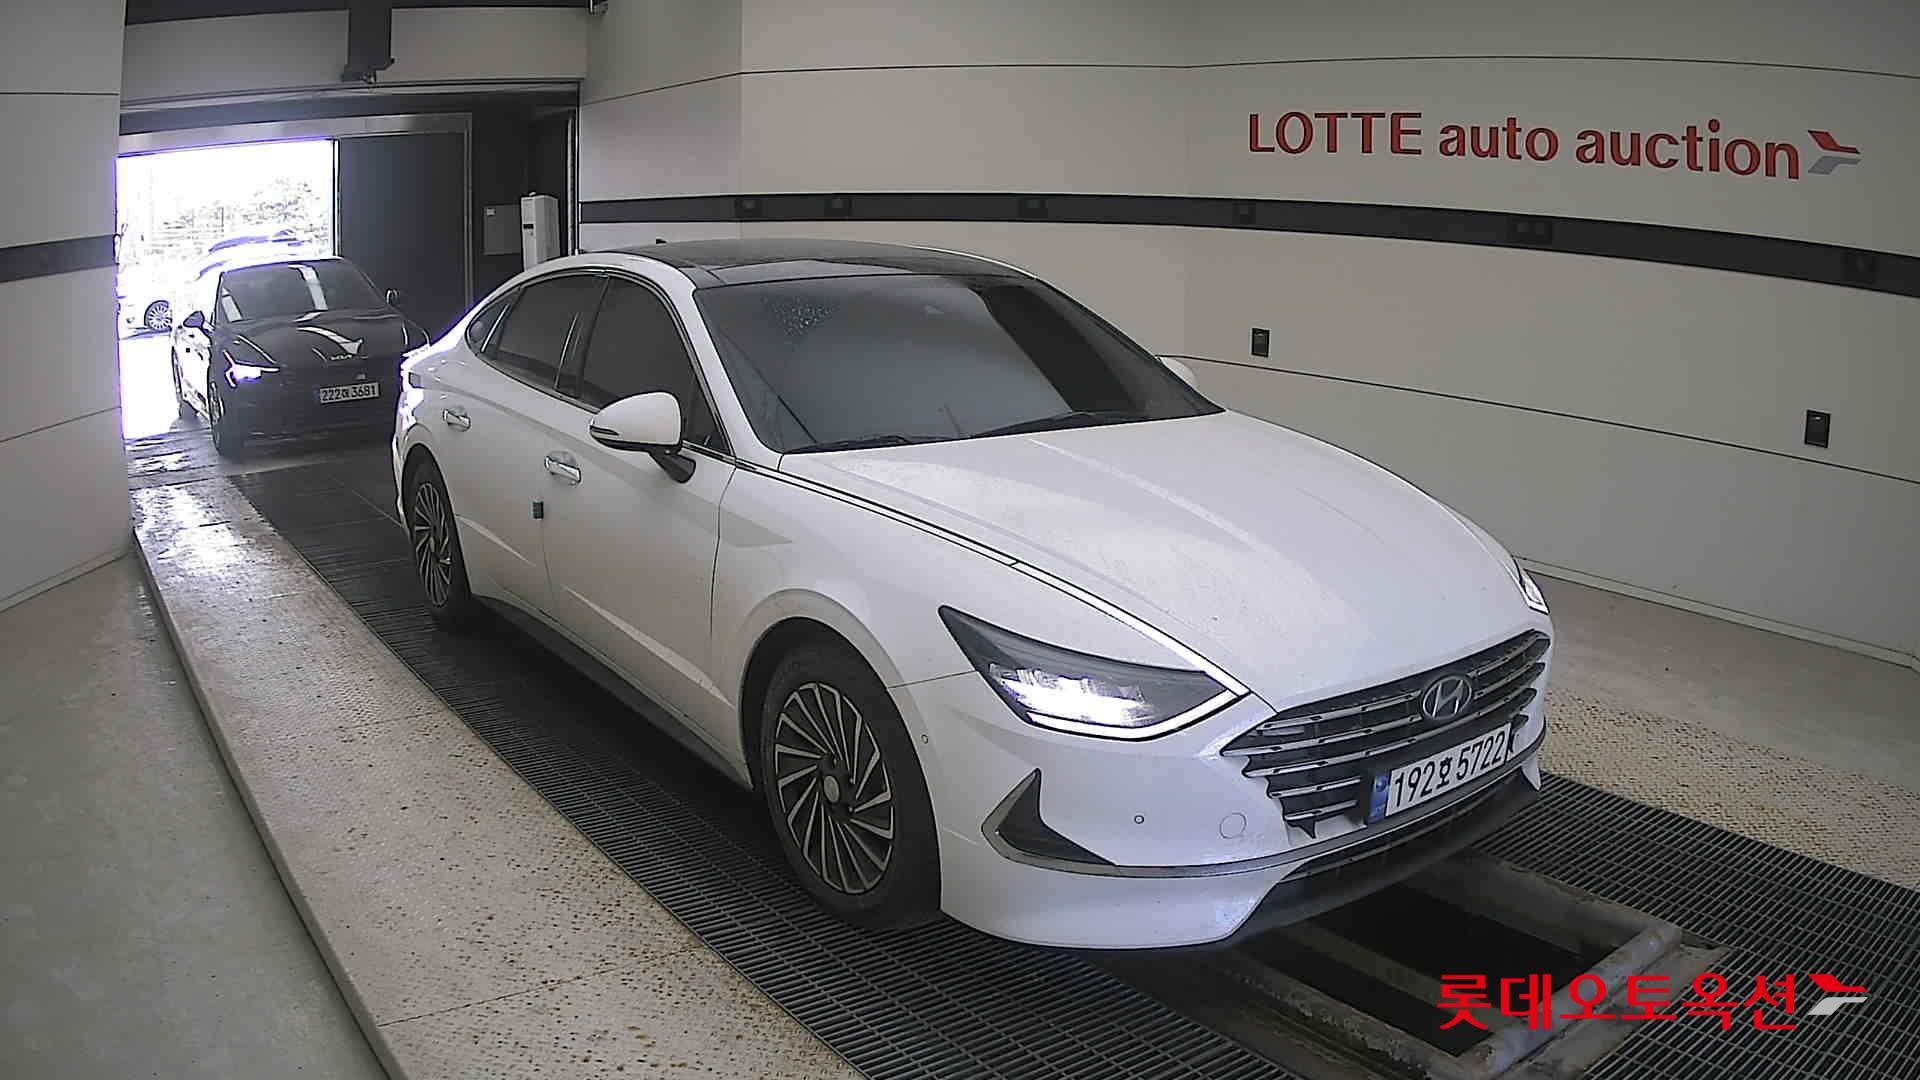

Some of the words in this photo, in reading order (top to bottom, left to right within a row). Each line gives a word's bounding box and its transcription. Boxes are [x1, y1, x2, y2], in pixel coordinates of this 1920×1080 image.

[1249, 112, 1423, 155] LOTTE
[1439, 117, 1560, 162] auto
[1575, 119, 1800, 180] auction
